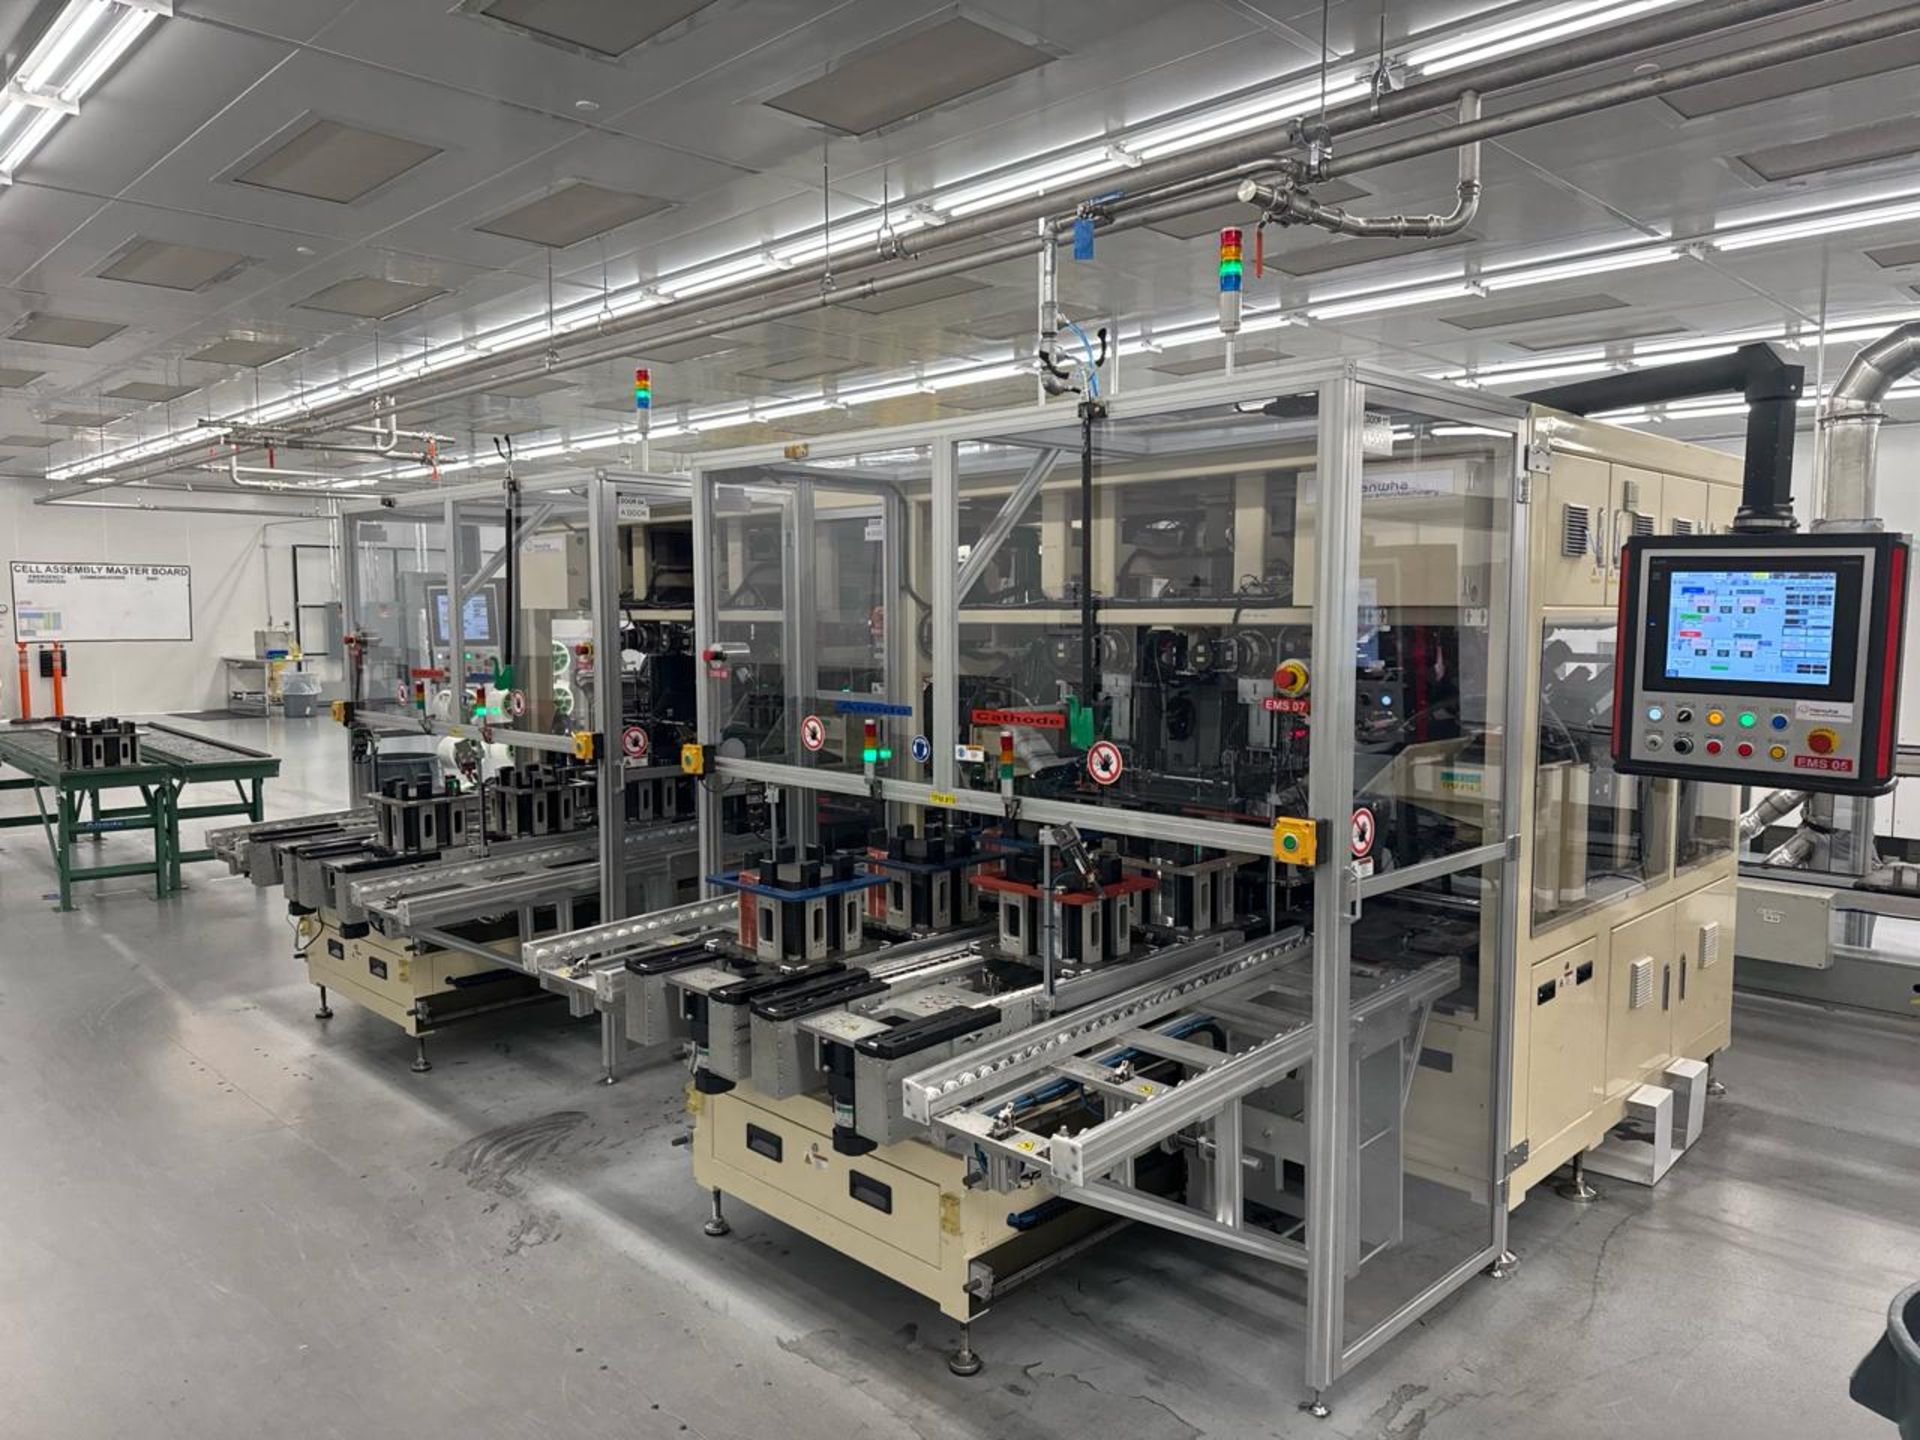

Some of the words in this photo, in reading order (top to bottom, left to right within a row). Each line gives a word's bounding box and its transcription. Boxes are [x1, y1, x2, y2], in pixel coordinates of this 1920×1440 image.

[1362, 481, 1409, 493] anwha
[13, 564, 43, 574] CELL
[44, 564, 104, 575] ASSEMBLY
[105, 566, 149, 576] MASTER
[151, 567, 189, 577] BOARD
[841, 701, 910, 716] Anode
[1265, 699, 1290, 711] EMS
[1292, 701, 1306, 712] 07
[975, 711, 1061, 725] Cathode
[1797, 757, 1828, 769] EMS
[1831, 759, 1849, 770] 05
